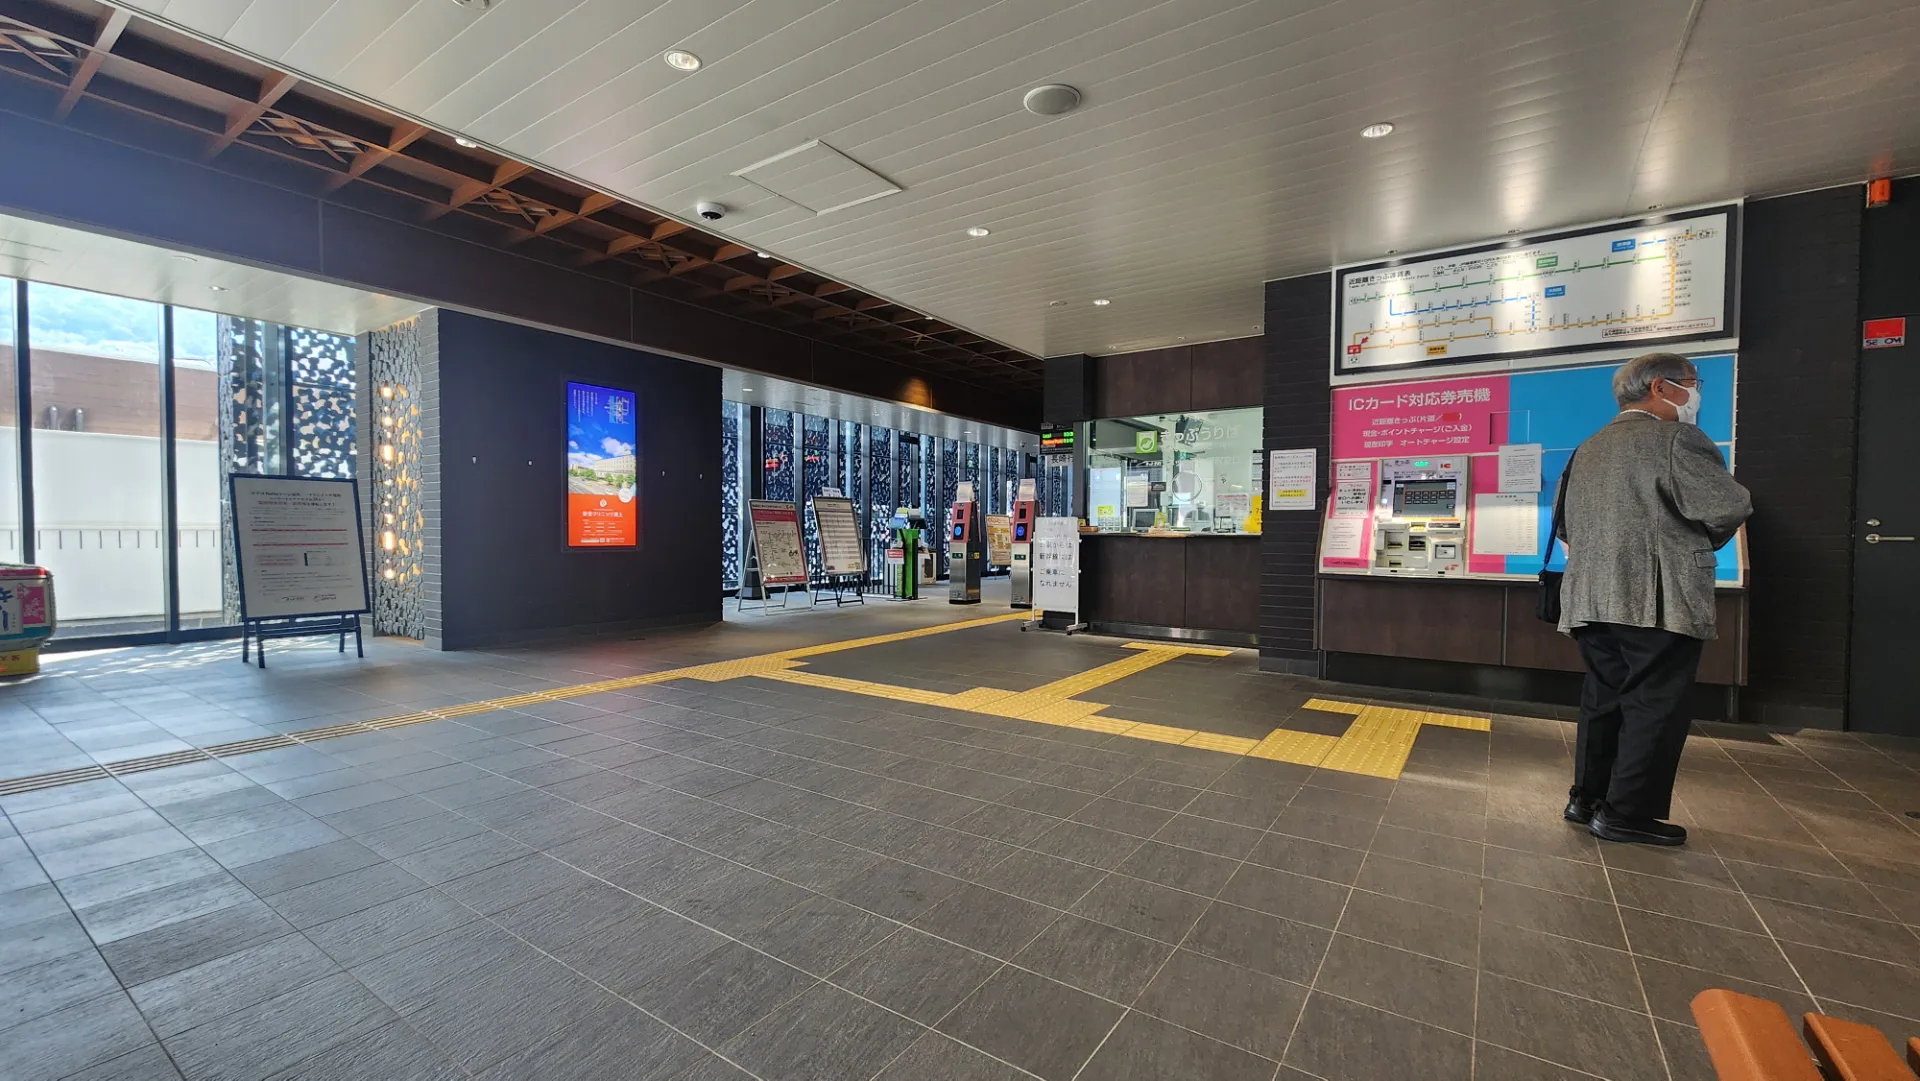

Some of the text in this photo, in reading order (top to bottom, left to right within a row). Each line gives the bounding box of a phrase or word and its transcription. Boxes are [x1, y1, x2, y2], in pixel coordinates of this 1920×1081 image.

[1866, 337, 1902, 346] SEOM
[1348, 387, 1491, 411] ICカード対応券売機
[1371, 412, 1463, 426] 近距離きっぷ(片道／)
[1160, 424, 1240, 443] きっぷうりば
[1039, 580, 1073, 588] なれません
